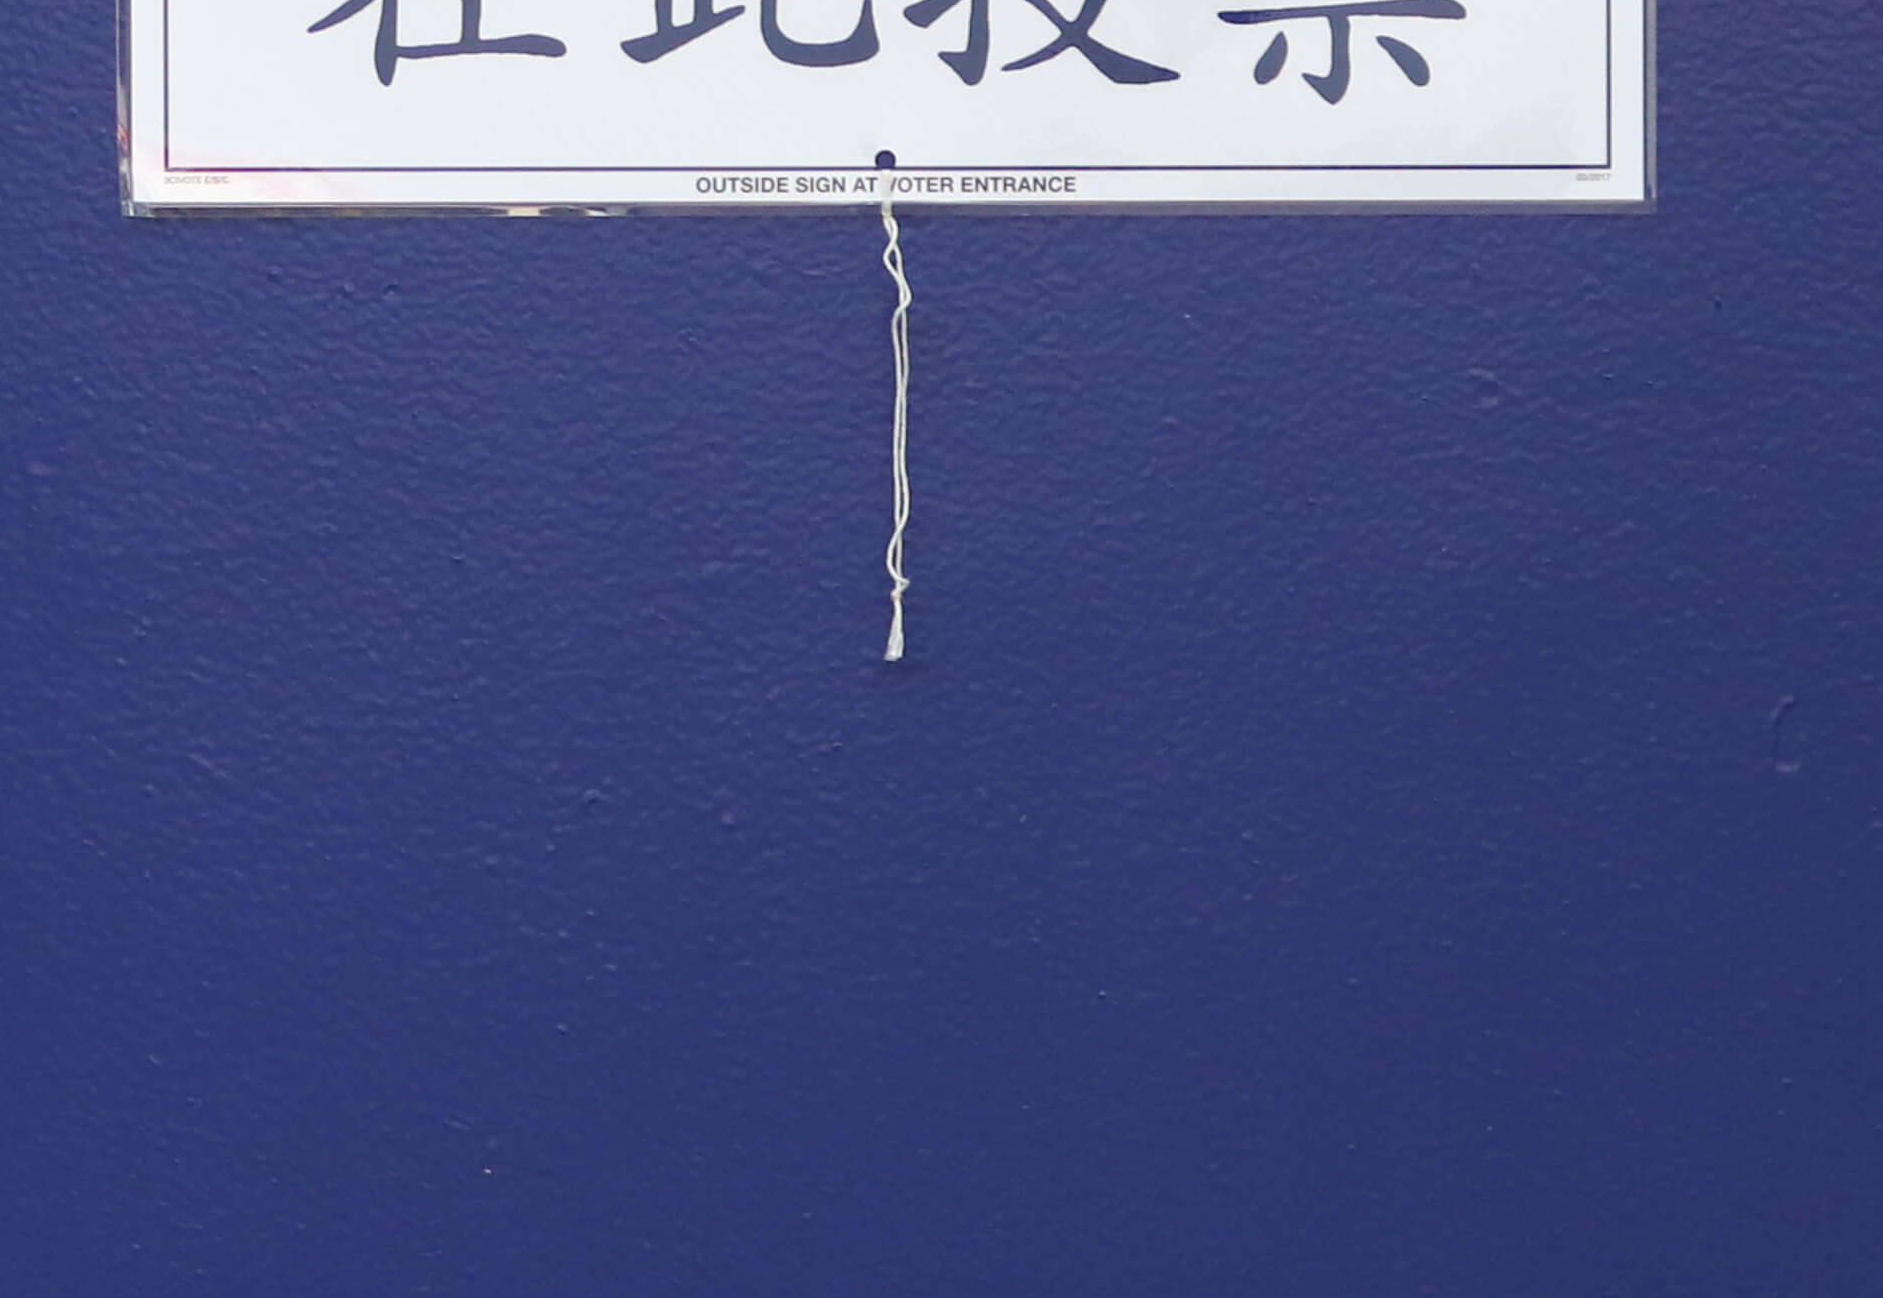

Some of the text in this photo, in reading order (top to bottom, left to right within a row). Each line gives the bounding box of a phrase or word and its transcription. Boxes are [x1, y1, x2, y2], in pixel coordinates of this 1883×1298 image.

[695, 176, 789, 194] OUTSIDE
[795, 176, 846, 194] SIGN
[852, 176, 879, 193] AT
[960, 176, 1076, 193] ENTRANCE
